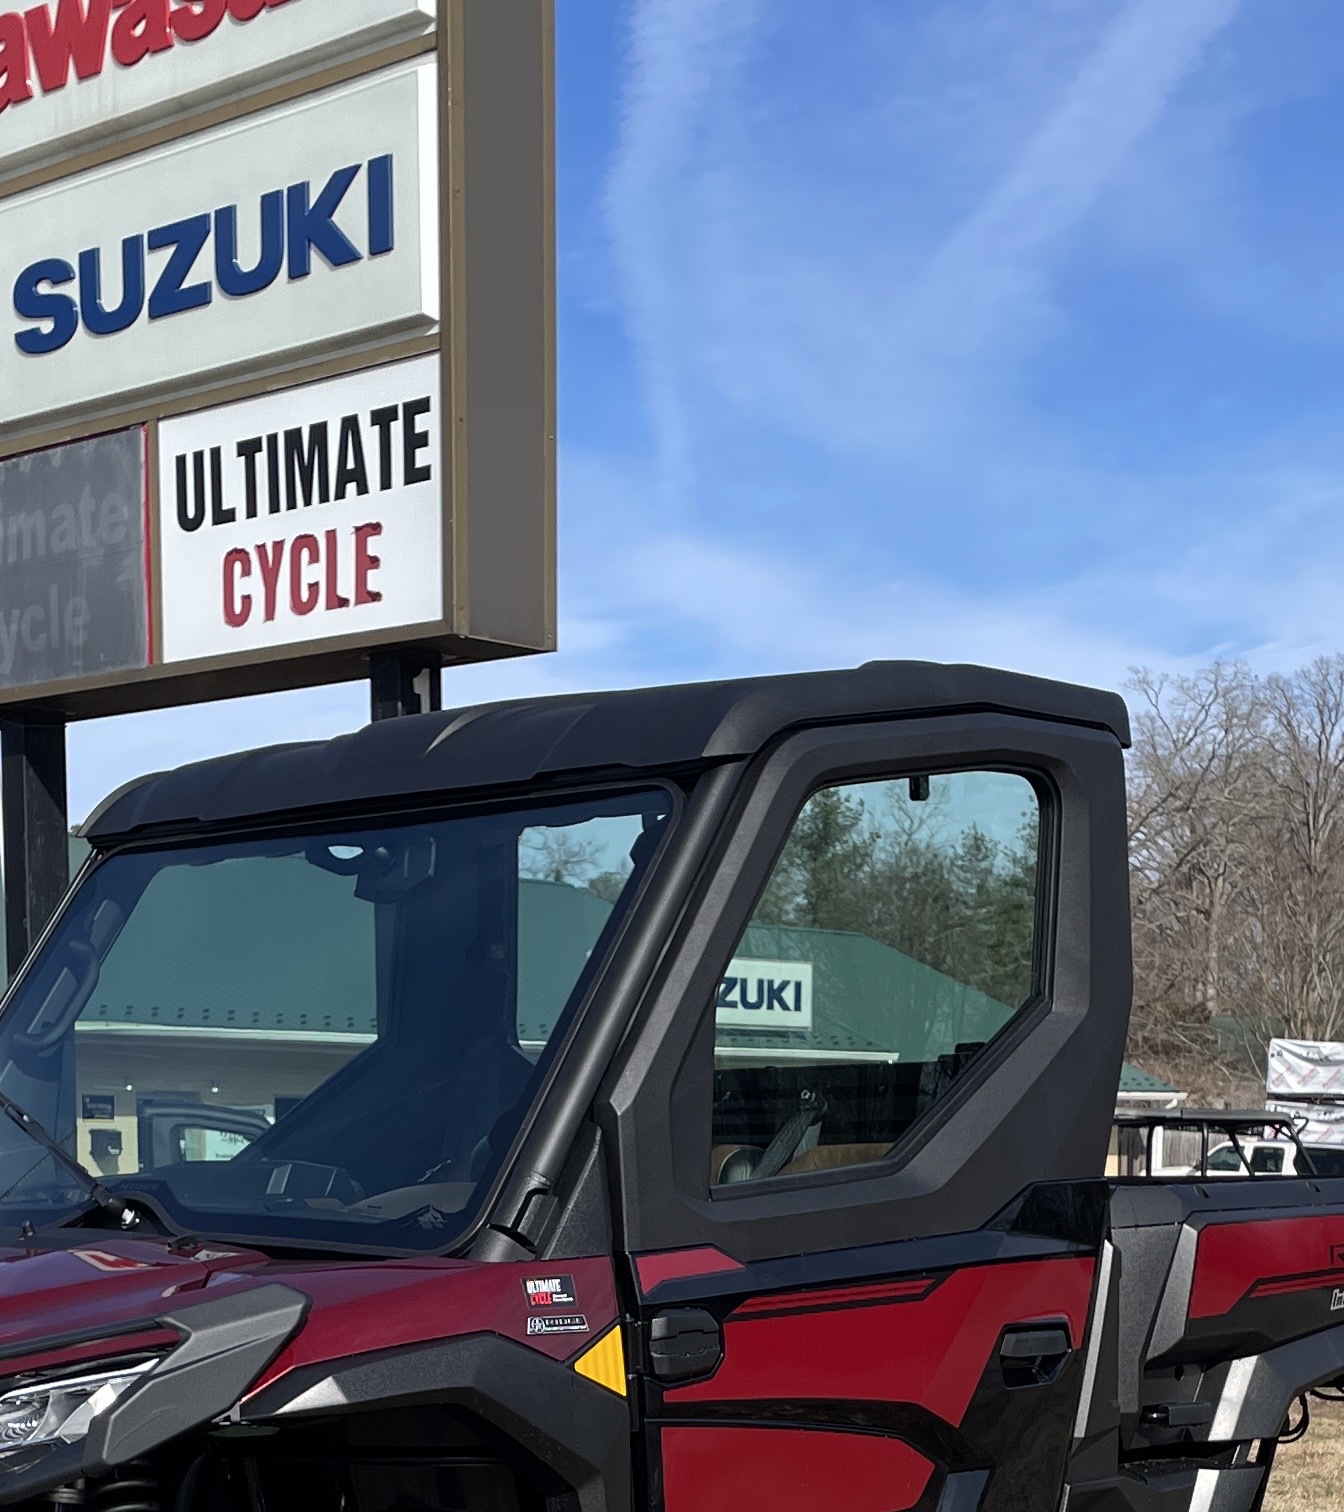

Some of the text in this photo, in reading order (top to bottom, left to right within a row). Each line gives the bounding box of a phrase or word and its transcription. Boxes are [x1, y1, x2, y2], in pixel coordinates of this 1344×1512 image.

[12, 153, 394, 355] SUZUKI
[175, 396, 432, 532] ULTIMATE
[222, 521, 383, 628] CYCLE
[716, 976, 802, 1012] ZUKI
[526, 1279, 562, 1294] ULTIMATE
[530, 1292, 552, 1306] CYCLE
